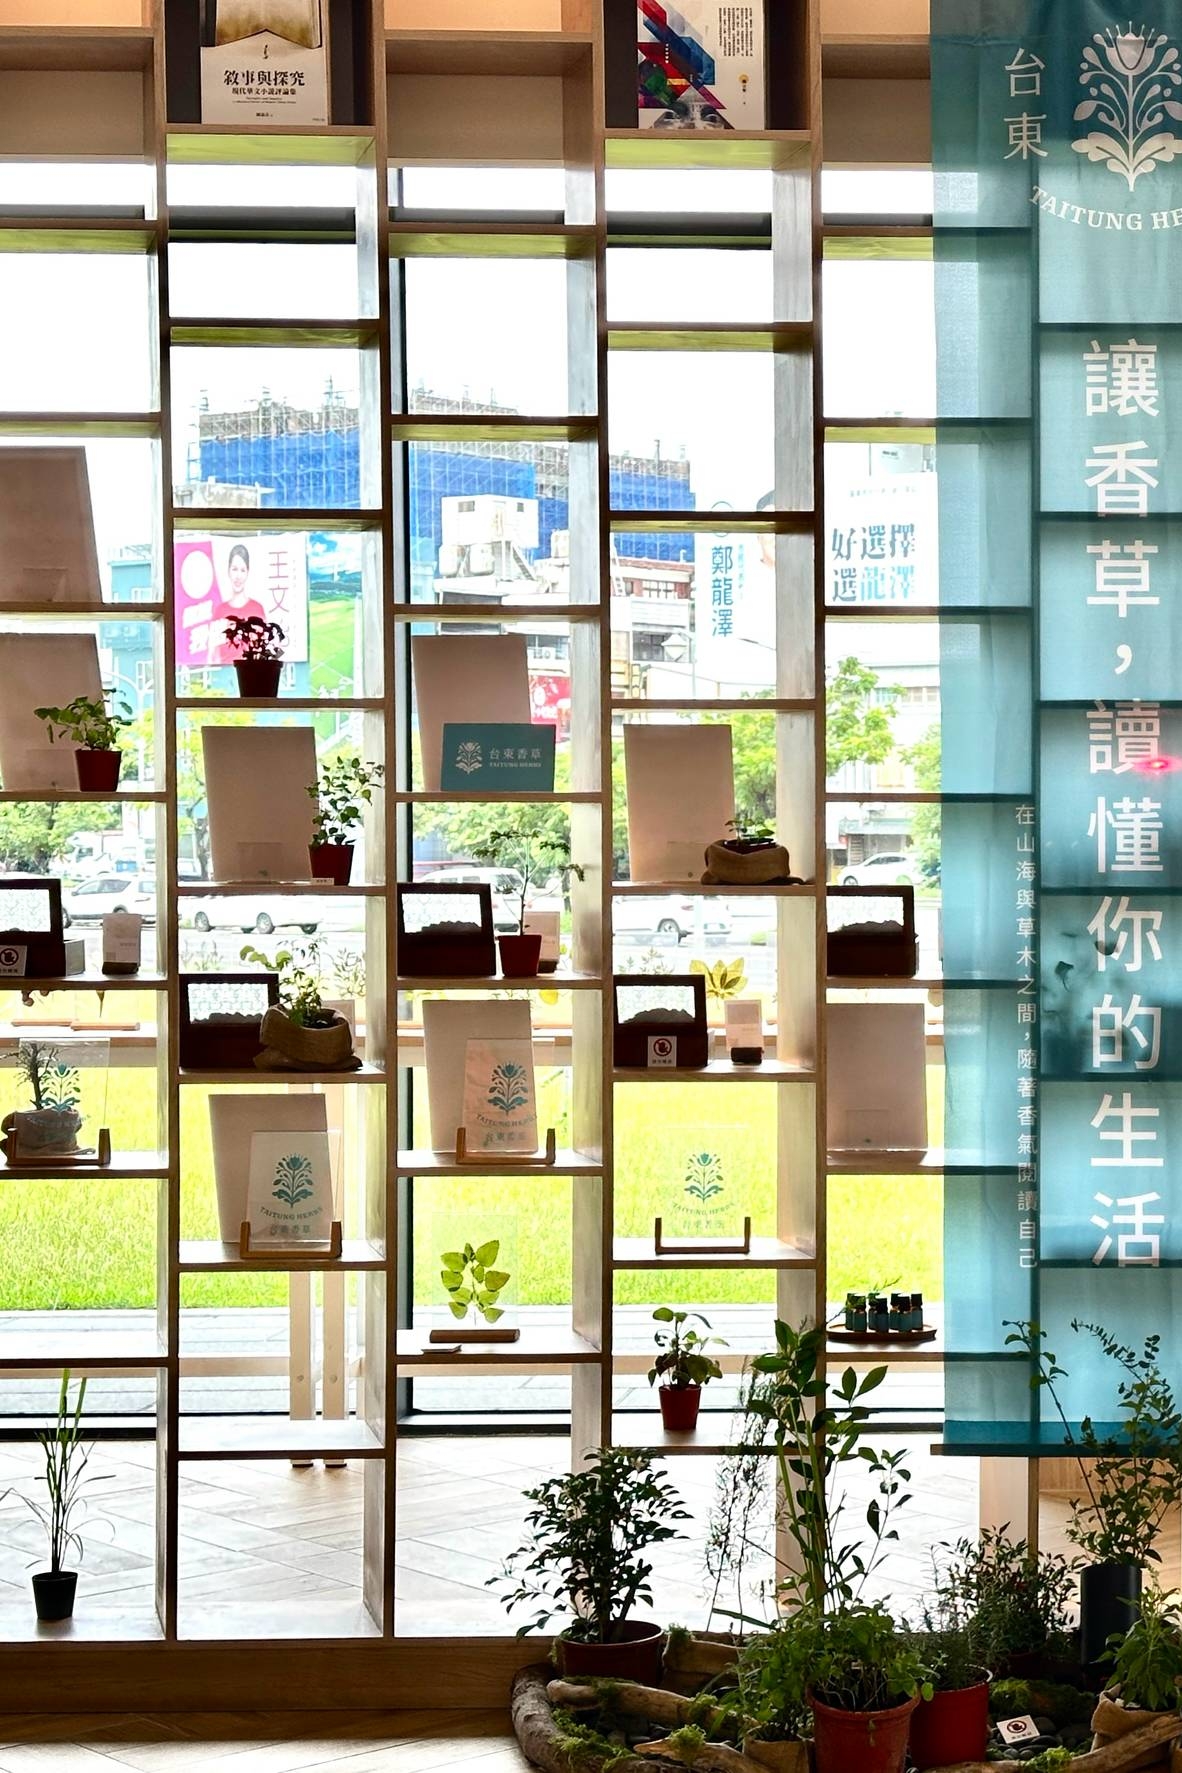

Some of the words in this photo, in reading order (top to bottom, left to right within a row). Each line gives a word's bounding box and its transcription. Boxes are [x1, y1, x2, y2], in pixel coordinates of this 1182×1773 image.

[223, 69, 305, 86] 敘事與探究
[1004, 48, 1048, 160] 台東
[1028, 185, 1143, 231] TAITUNG
[832, 523, 915, 561] 好選擇
[711, 545, 733, 637] 鄭龍澤
[832, 565, 915, 602] 選龍澤
